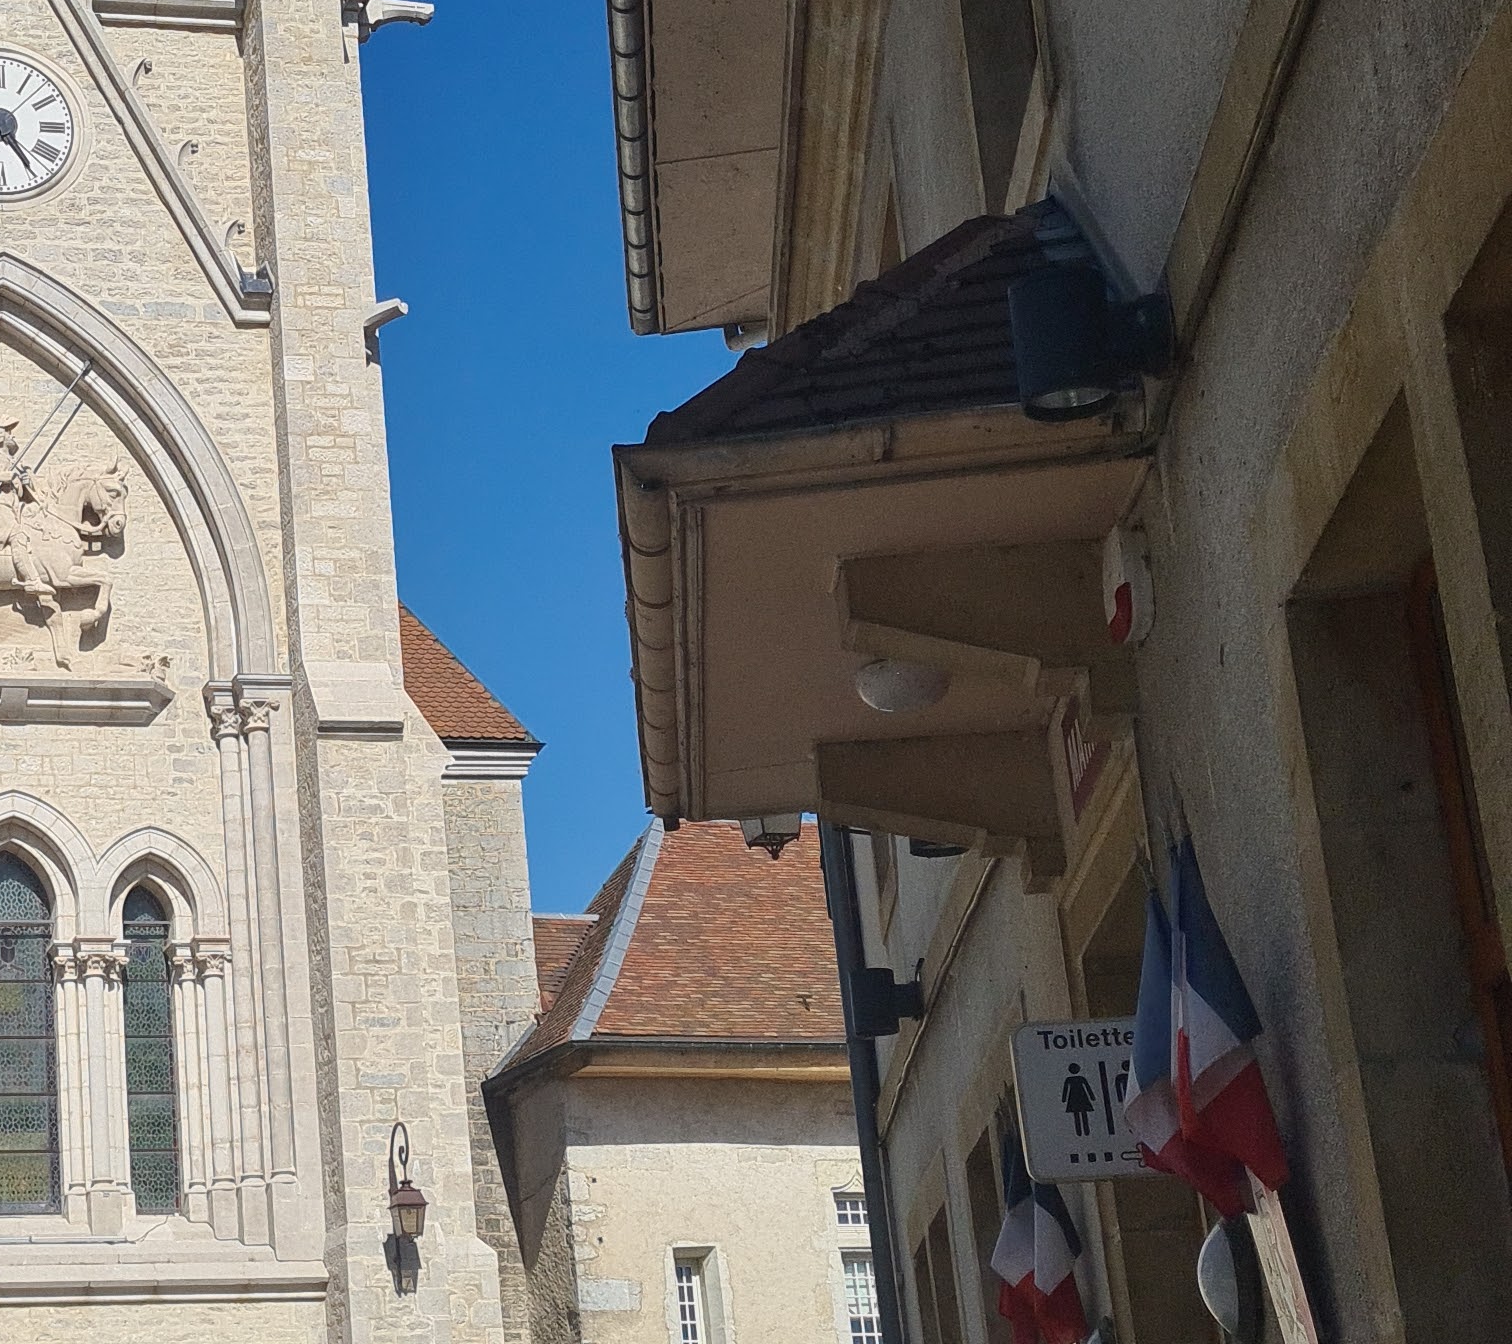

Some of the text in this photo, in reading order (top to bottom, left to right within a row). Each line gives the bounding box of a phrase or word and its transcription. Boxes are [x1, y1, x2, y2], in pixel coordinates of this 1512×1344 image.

[16, 73, 33, 95] I
[31, 94, 57, 111] II
[39, 121, 65, 134] III
[31, 139, 61, 164] IIII
[1037, 1027, 1136, 1050] Toilette
